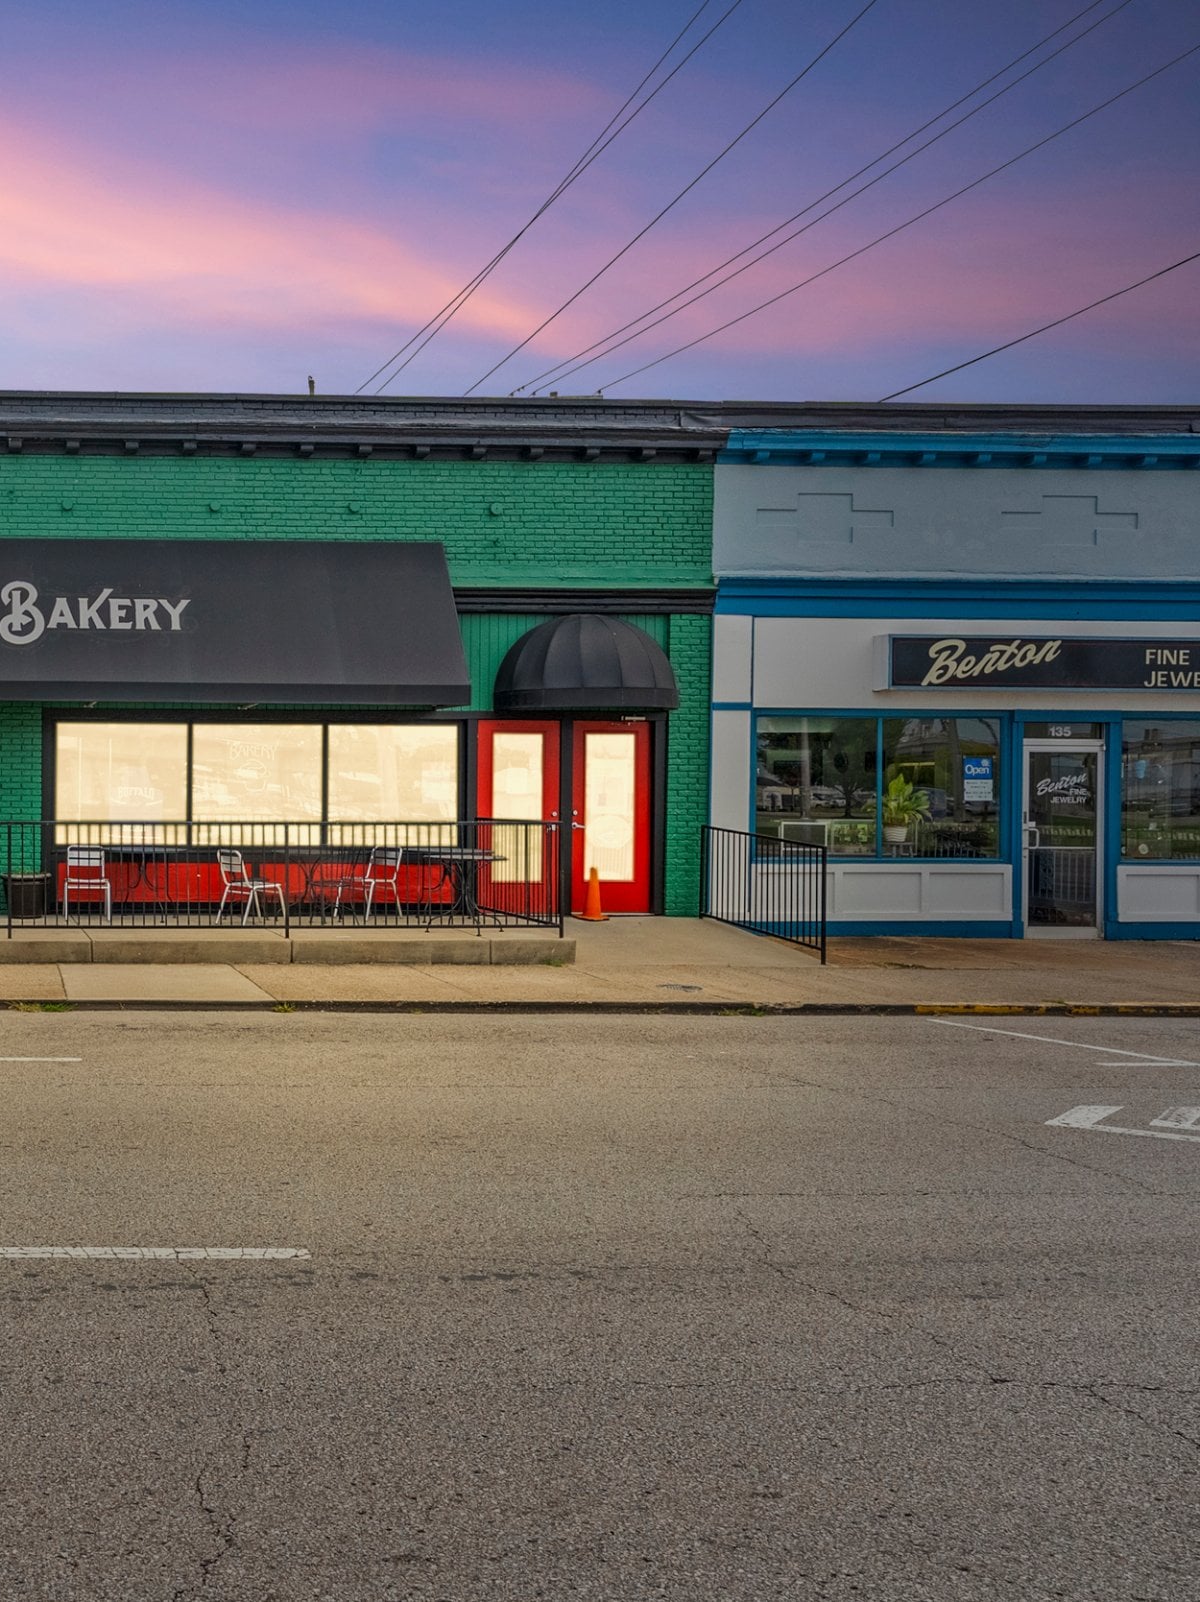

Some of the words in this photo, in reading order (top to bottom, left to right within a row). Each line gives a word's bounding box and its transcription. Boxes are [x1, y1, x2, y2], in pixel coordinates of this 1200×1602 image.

[921, 639, 1062, 686] Benton
[1145, 649, 1190, 665] FINE
[1049, 725, 1072, 737] 135
[230, 742, 280, 761] BAKERY
[965, 764, 990, 776] Open
[1036, 773, 1087, 796] Benton
[1069, 788, 1087, 796] FINE
[1050, 796, 1087, 804] JEWELRY
